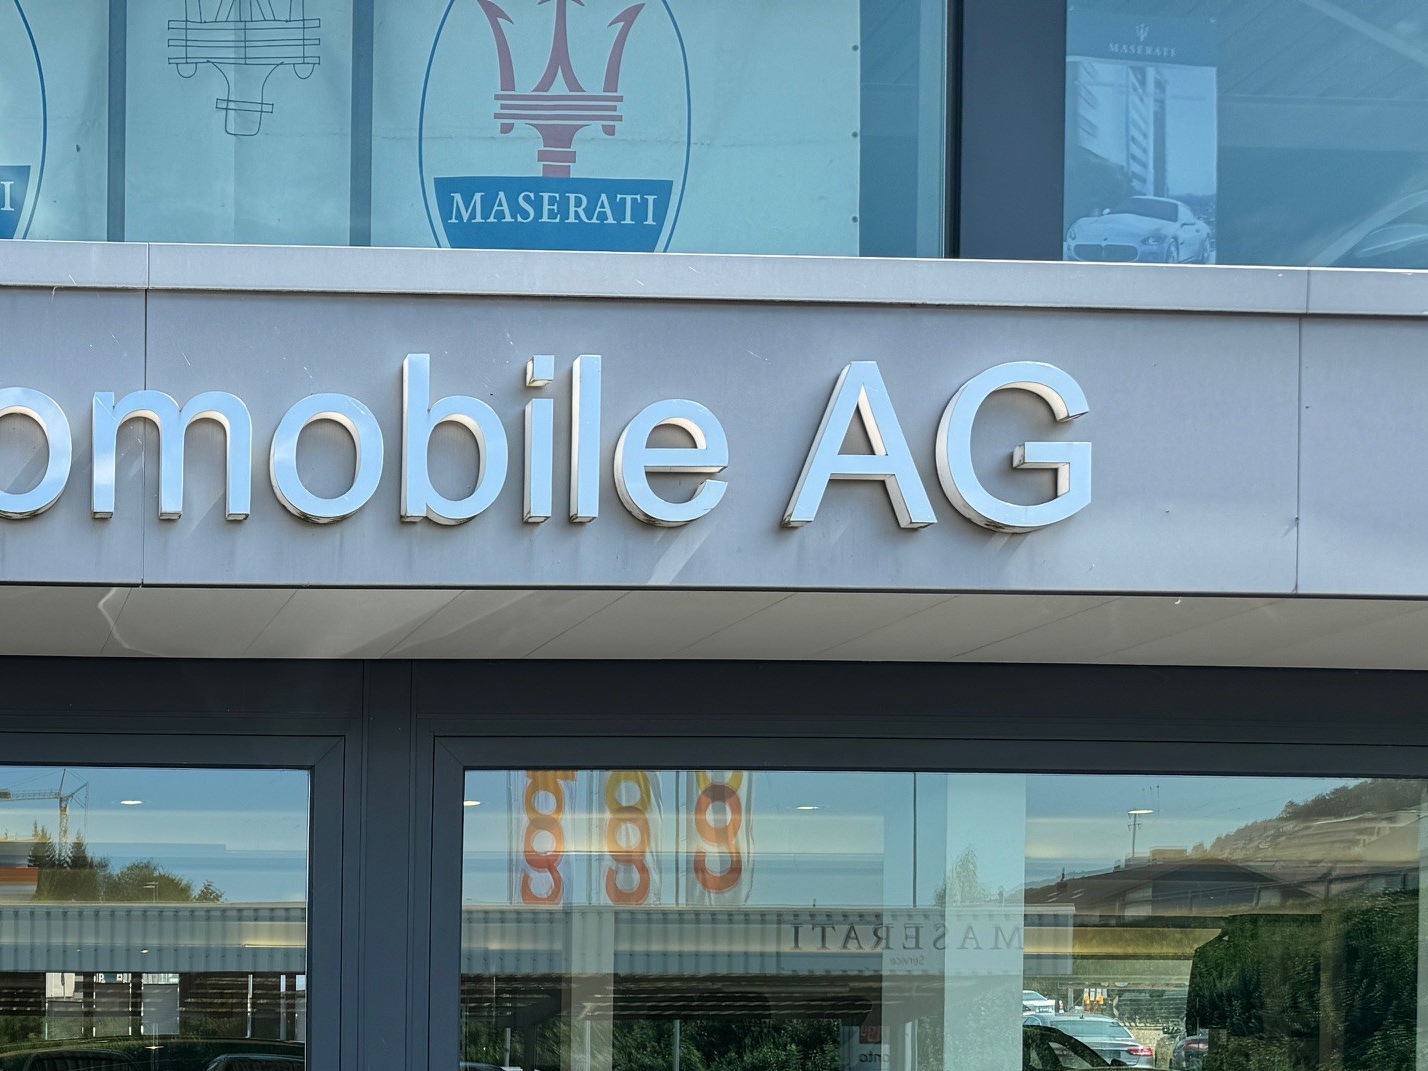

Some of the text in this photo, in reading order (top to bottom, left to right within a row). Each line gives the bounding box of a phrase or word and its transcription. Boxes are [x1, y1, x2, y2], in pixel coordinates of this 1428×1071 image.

[1108, 43, 1176, 57] MASERATI
[448, 190, 659, 227] MASERATI
[780, 361, 1094, 533] AG
